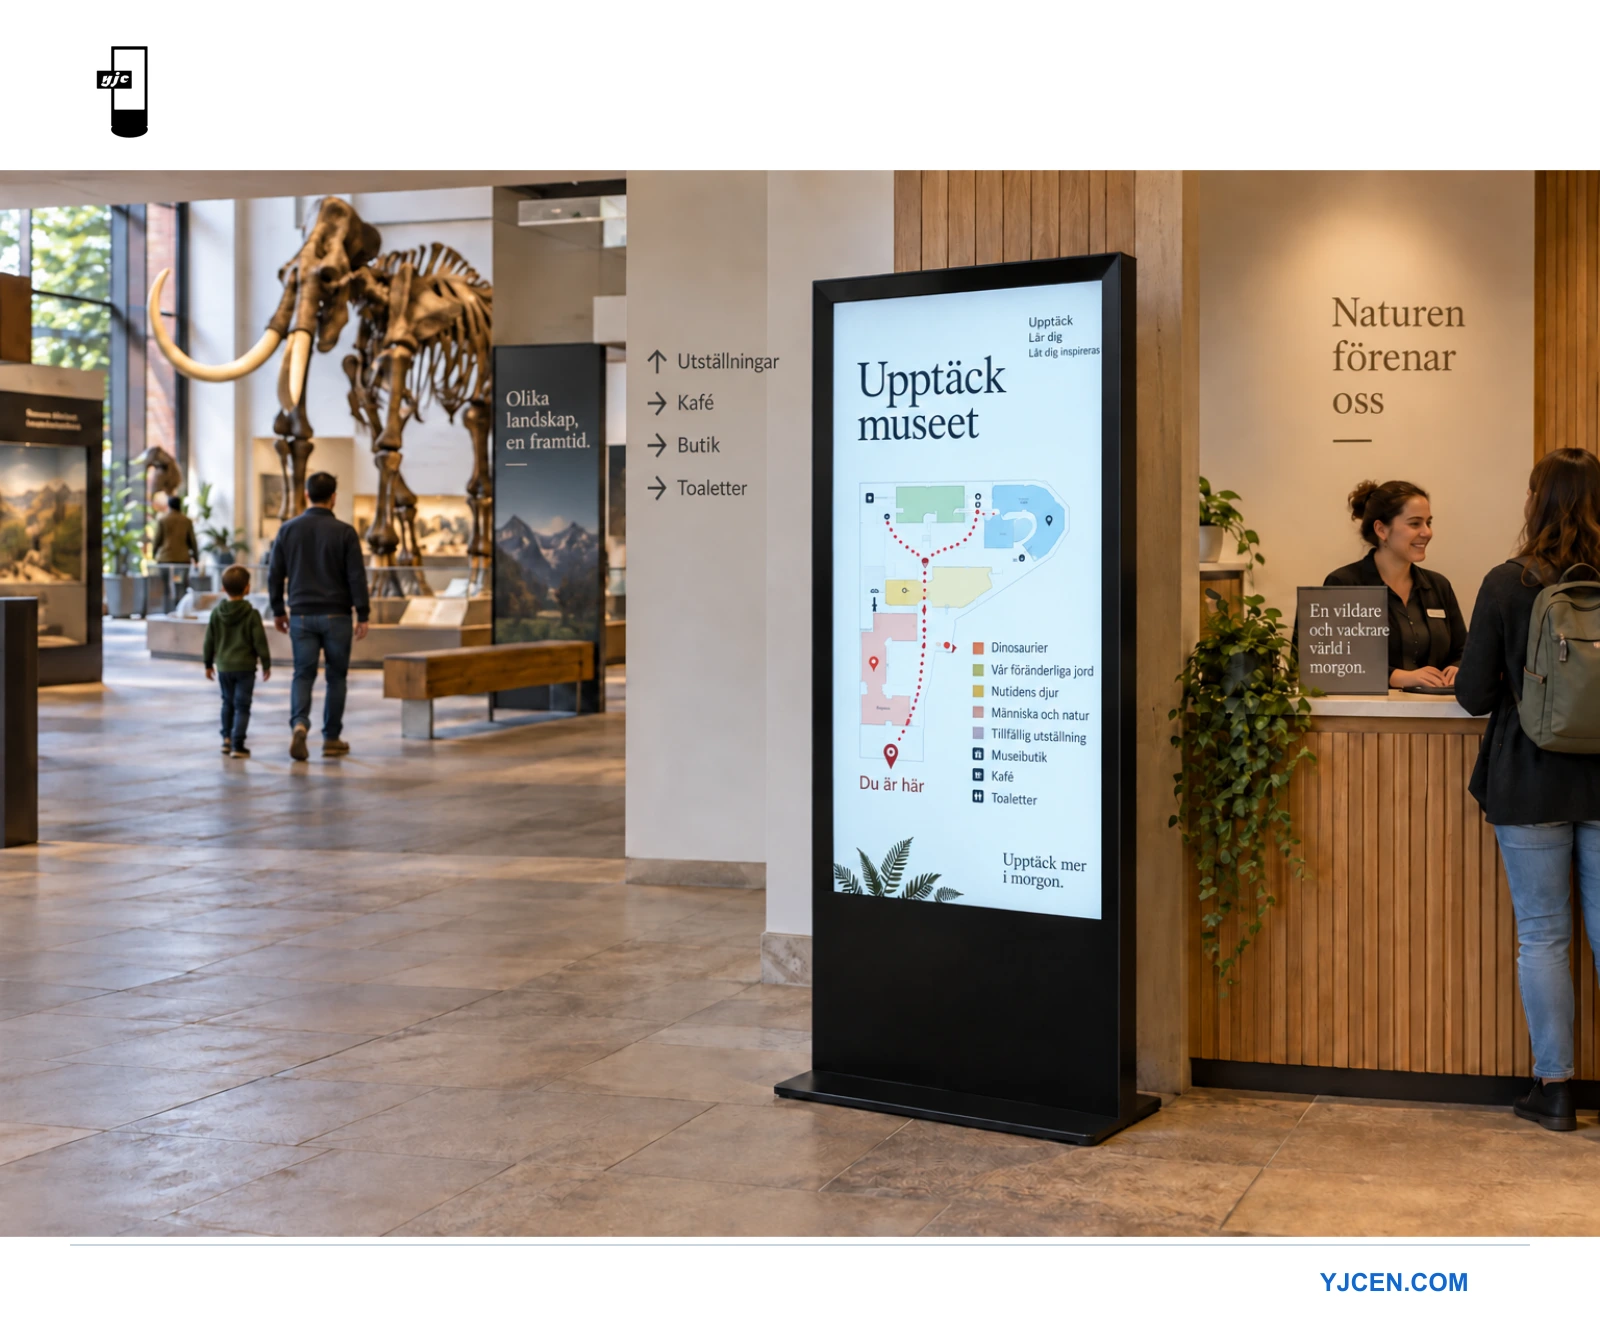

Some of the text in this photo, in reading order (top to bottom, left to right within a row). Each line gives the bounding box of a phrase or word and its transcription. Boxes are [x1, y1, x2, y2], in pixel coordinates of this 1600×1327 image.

[1332, 296, 1466, 328] Naturen
[1028, 314, 1073, 330] Upptäck
[1047, 331, 1063, 344] dig
[1028, 346, 1101, 359] Låt dig inspireras
[1332, 339, 1457, 372] förenar
[678, 352, 780, 373] Utställningar
[857, 355, 1007, 408] Upptäck
[506, 390, 550, 407] Olika
[678, 393, 714, 412] Kafé
[1332, 390, 1385, 415] oss
[506, 410, 579, 431] landskap,
[857, 406, 980, 441] museet
[506, 432, 591, 451] en framtid.
[678, 436, 721, 454] Butik
[677, 479, 748, 498] Toaletter
[1309, 602, 1382, 618] En vildare
[1309, 622, 1390, 637] och vackrare
[991, 641, 1048, 654] Dinosaurier
[1309, 641, 1351, 655] värld i
[991, 664, 1094, 679] Vår föränderliga jord
[1309, 663, 1366, 677] morgon.
[991, 685, 1059, 700] Nutidens djur
[991, 707, 1090, 721] Människa och natur
[991, 728, 1087, 746] Tillfällig utställning
[991, 749, 1048, 763] Museibutik
[859, 775, 925, 793] Du är här
[991, 770, 1014, 783] Kafé
[991, 792, 1038, 806] Toaletter
[1002, 852, 1087, 872] Upptäck mer
[1003, 870, 1064, 890] i morgon.
